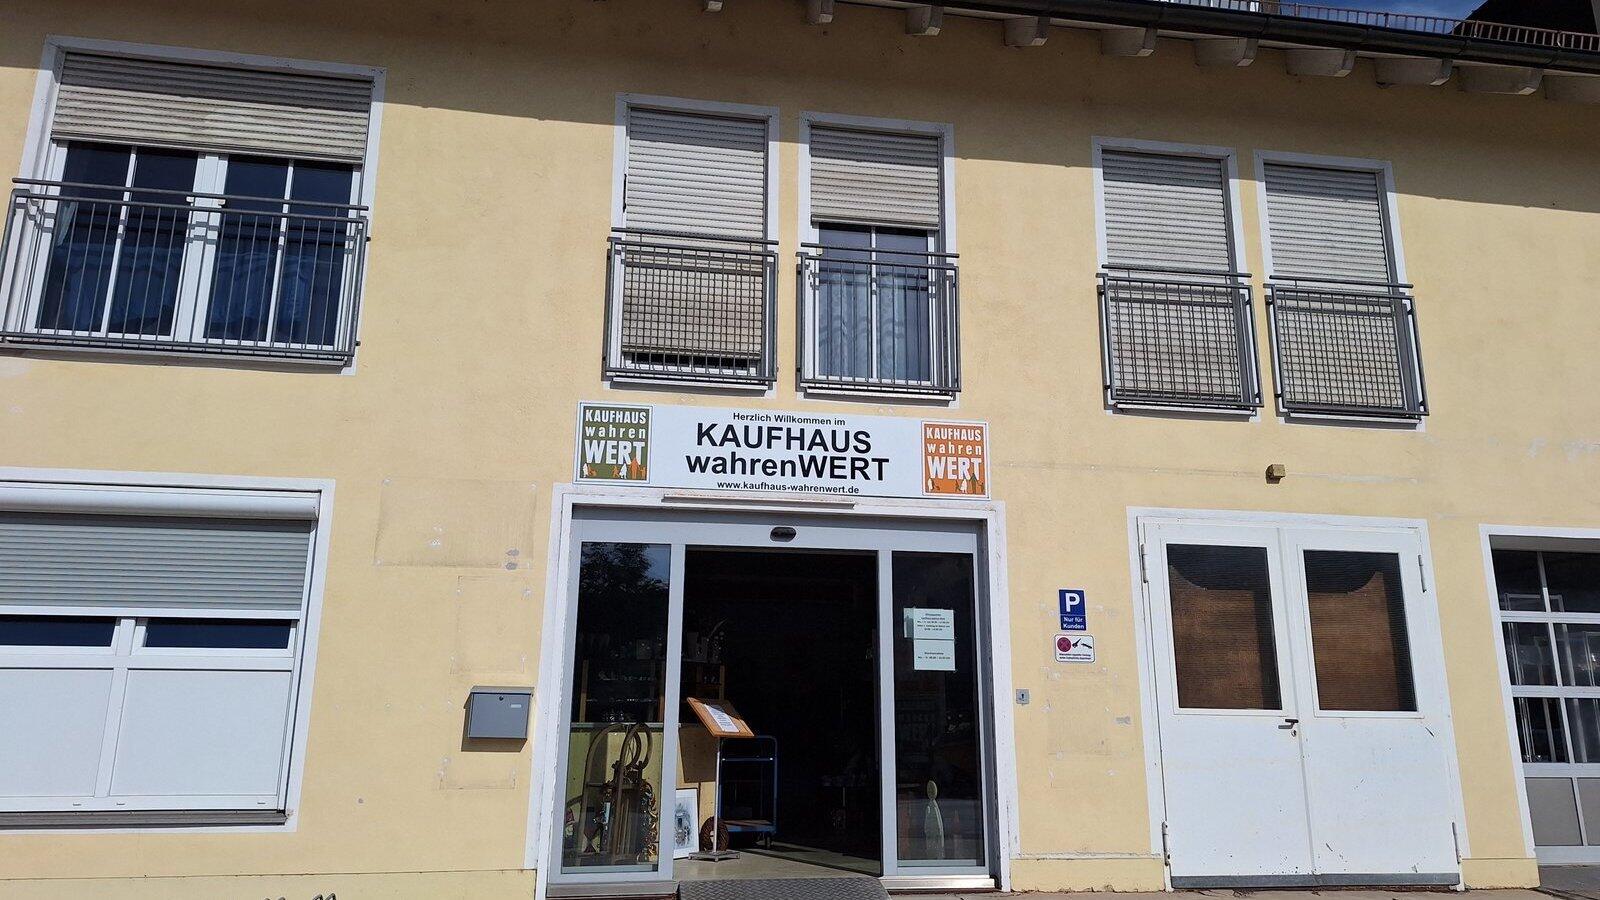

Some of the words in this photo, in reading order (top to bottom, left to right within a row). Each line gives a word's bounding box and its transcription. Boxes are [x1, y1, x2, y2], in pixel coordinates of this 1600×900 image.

[585, 409, 647, 425] KAUFHAUS
[733, 412, 772, 423] Herzlich
[774, 414, 832, 426] Willkommen
[834, 417, 846, 426] im
[585, 424, 646, 439] wahren
[697, 422, 872, 454] KAUFHAUS
[926, 427, 981, 442] KAUFHAUS
[584, 439, 645, 466] WERT
[927, 441, 982, 456] wahren
[685, 451, 890, 481] wahrenWERT
[927, 455, 982, 481] WERT
[717, 481, 860, 495] www.kaufhaus-wahrenwert.de
[1065, 592, 1080, 612] P
